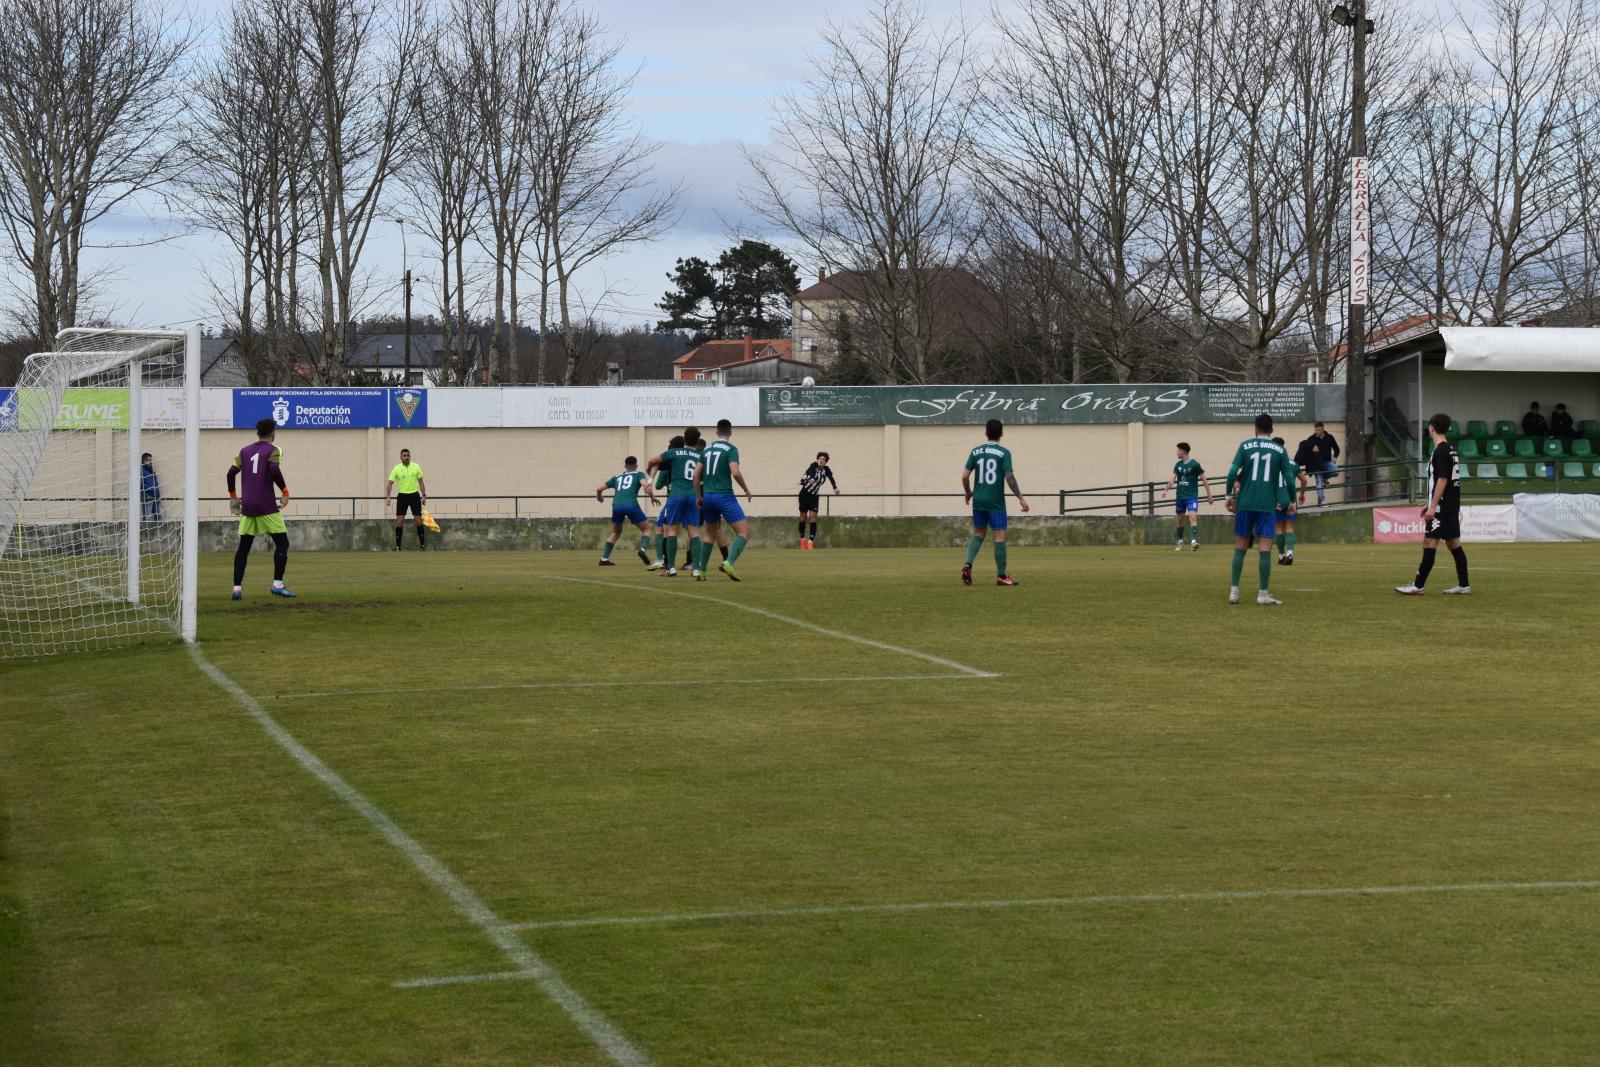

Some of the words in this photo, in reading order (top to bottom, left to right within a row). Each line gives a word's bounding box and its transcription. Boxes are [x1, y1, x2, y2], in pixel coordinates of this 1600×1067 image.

[1354, 158, 1368, 242] FERRALLA
[296, 405, 351, 417] Deputación
[896, 389, 1046, 418] Fibra
[296, 416, 309, 425] DA
[311, 414, 351, 425] CORUÑA
[250, 453, 260, 474] 1
[684, 459, 697, 481] 6
[704, 451, 721, 476] 17
[976, 458, 997, 485] 18
[1250, 451, 1272, 482] 11
[616, 475, 633, 491] 19
